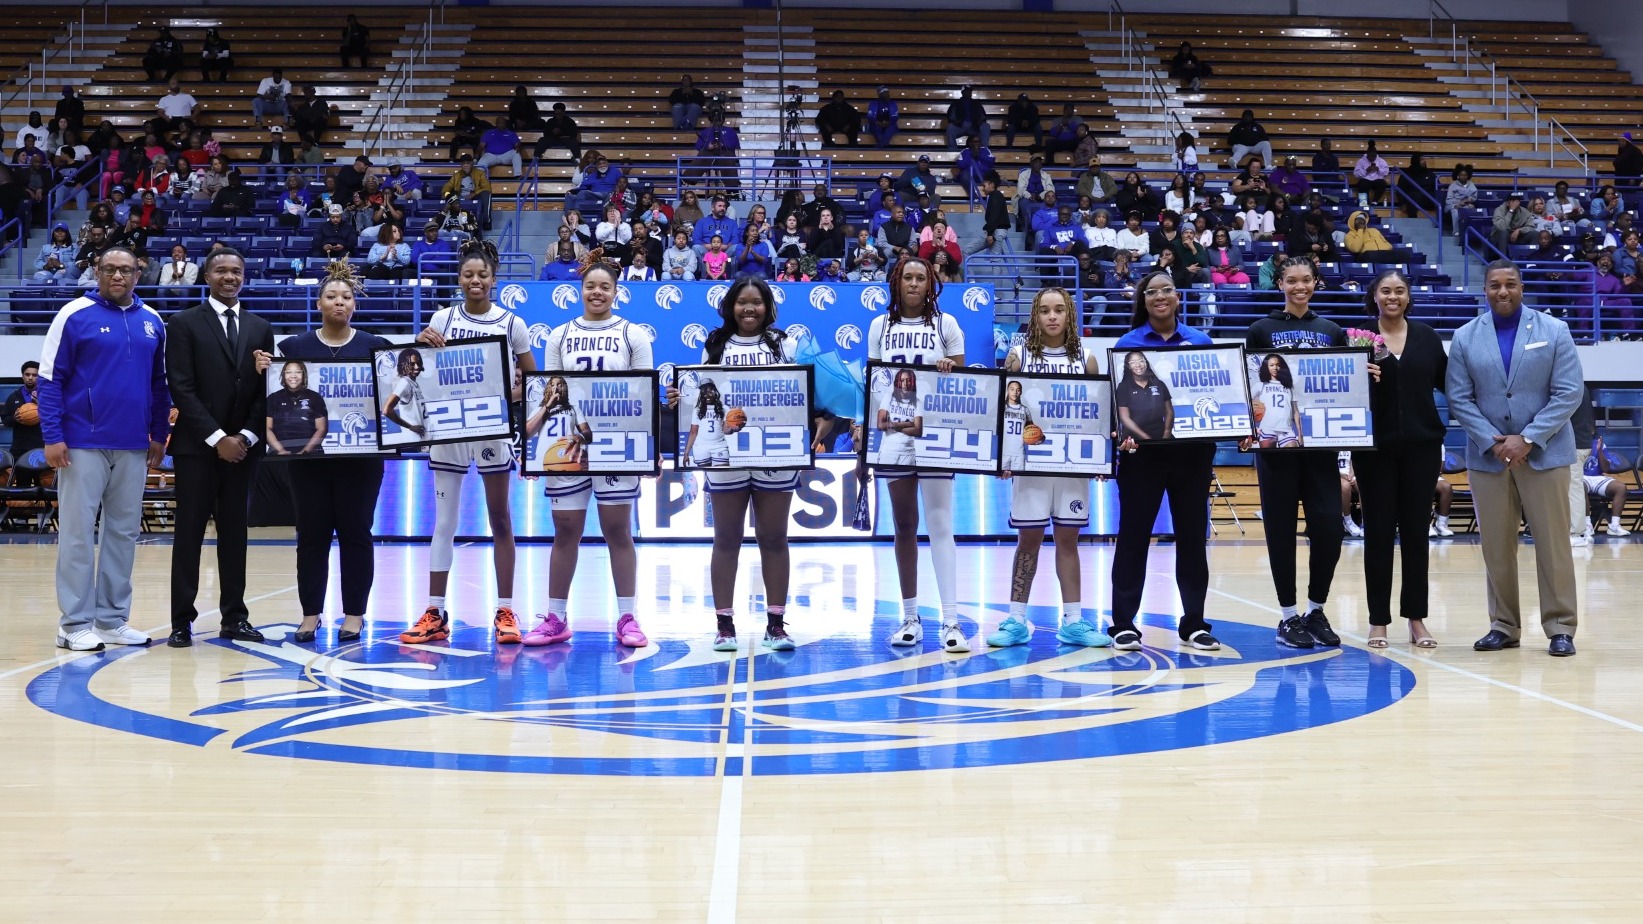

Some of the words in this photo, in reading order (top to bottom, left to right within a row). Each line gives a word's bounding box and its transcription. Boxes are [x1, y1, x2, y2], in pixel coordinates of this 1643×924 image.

[451, 327, 494, 340] BRON
[885, 332, 936, 350] BRONCOS
[1271, 330, 1315, 341] FAYETTEVILLE
[566, 337, 619, 354] BRONCOS
[436, 348, 485, 368] AMINA
[725, 352, 773, 366] BRONCO
[1177, 353, 1220, 370] AISHA
[1298, 358, 1355, 376] AMIRAH
[319, 366, 373, 384] SHA'LIZ
[438, 366, 484, 386] MILES
[1027, 363, 1080, 375] BRONCOS
[1170, 369, 1231, 387] VAUGHN
[318, 384, 374, 399] BLACKMO
[591, 382, 628, 399] NYAH
[730, 380, 799, 393] TANJANEEKA
[936, 377, 977, 396] KELIS
[1051, 383, 1088, 401] TALIA
[1304, 376, 1350, 394] ALLEN
[578, 399, 643, 417] WILKINS
[724, 393, 805, 407] EICHELBERGER
[923, 394, 988, 415] CARMON
[1272, 394, 1285, 408] 12
[424, 395, 504, 432] 22
[890, 404, 915, 418] BRONCOS
[1038, 401, 1099, 419] TROTTER
[547, 416, 566, 437] 21
[707, 420, 715, 433] 3
[1007, 420, 1022, 435] 30
[1173, 414, 1252, 432] 2026
[1304, 406, 1367, 438] 12
[321, 432, 377, 447] 202
[588, 430, 648, 462] 21
[729, 425, 805, 457] 03
[914, 426, 993, 462] 24
[1026, 432, 1107, 465] 30
[656, 467, 857, 529] PSI
